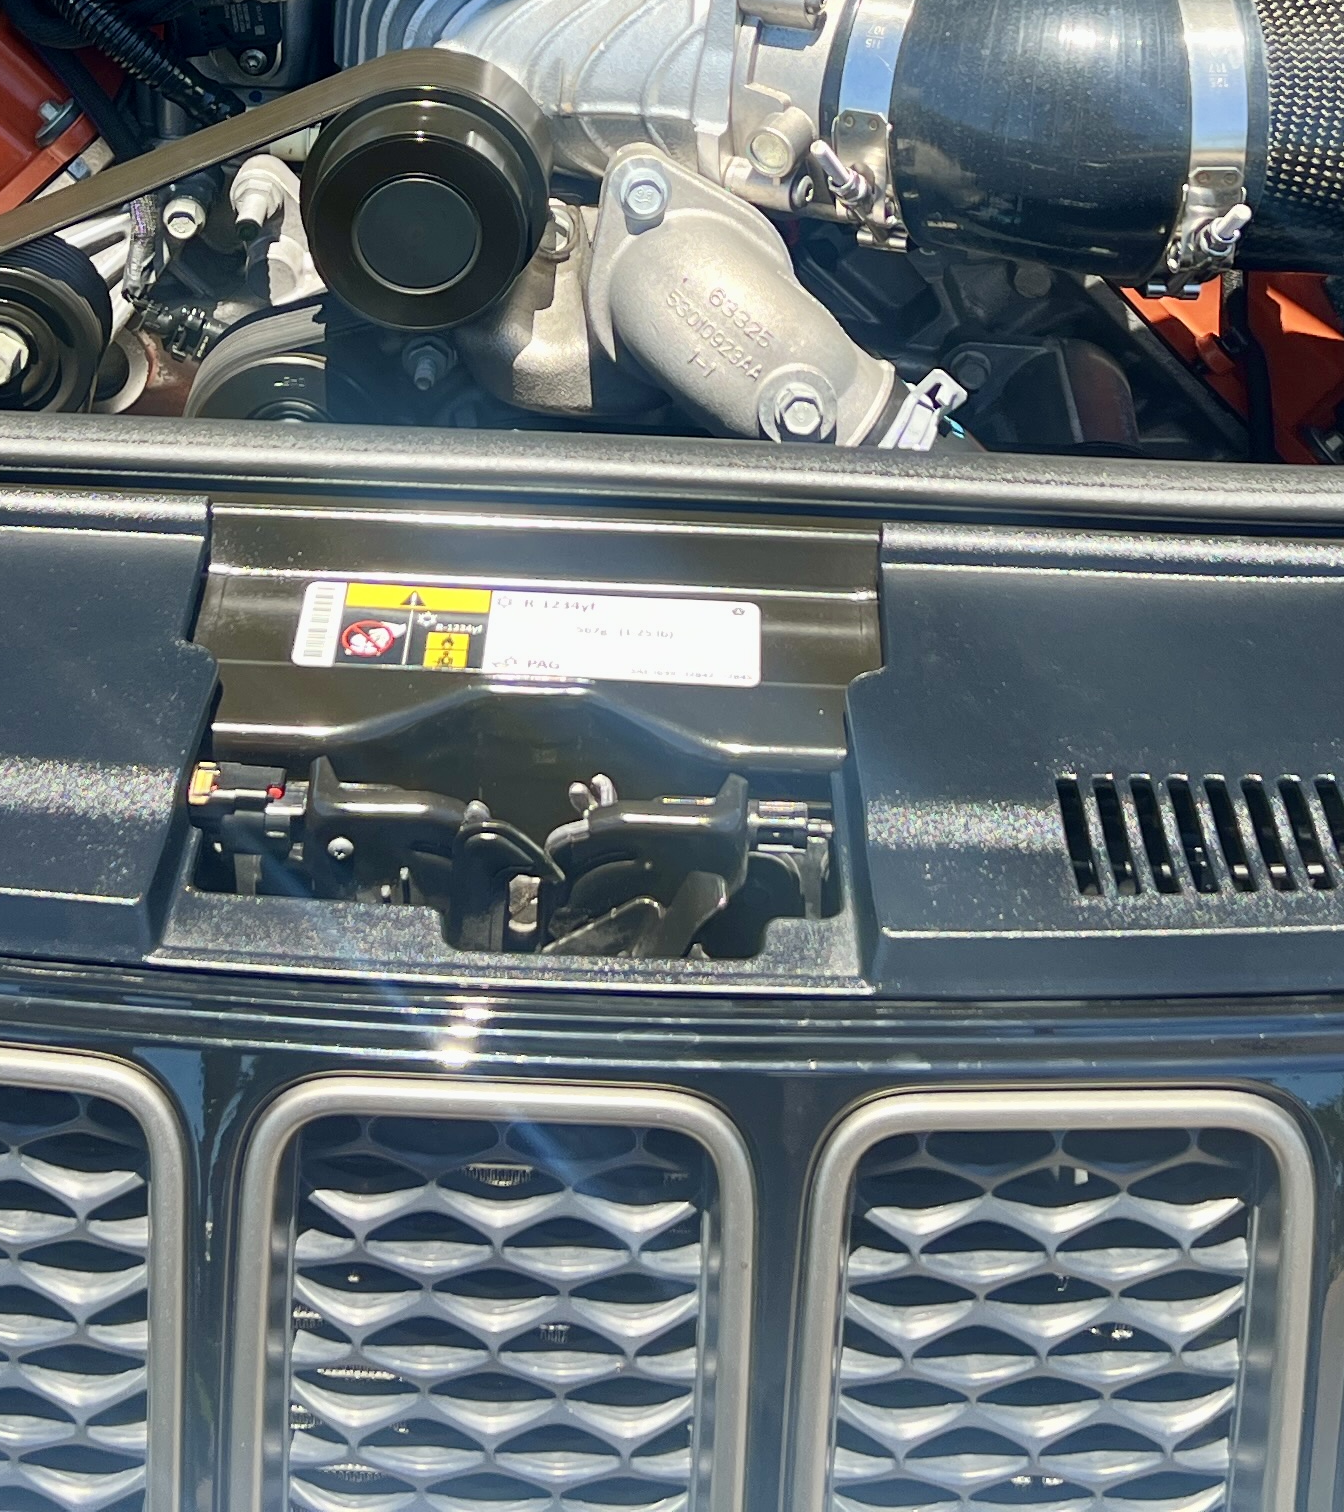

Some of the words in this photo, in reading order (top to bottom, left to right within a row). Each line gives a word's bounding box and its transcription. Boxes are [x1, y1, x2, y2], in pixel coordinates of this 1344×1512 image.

[709, 287, 775, 348] 63325
[666, 288, 763, 382] 53010923AA
[523, 598, 596, 613] R1234yf
[435, 623, 483, 635] R-1234yf
[526, 659, 560, 670] PAG
